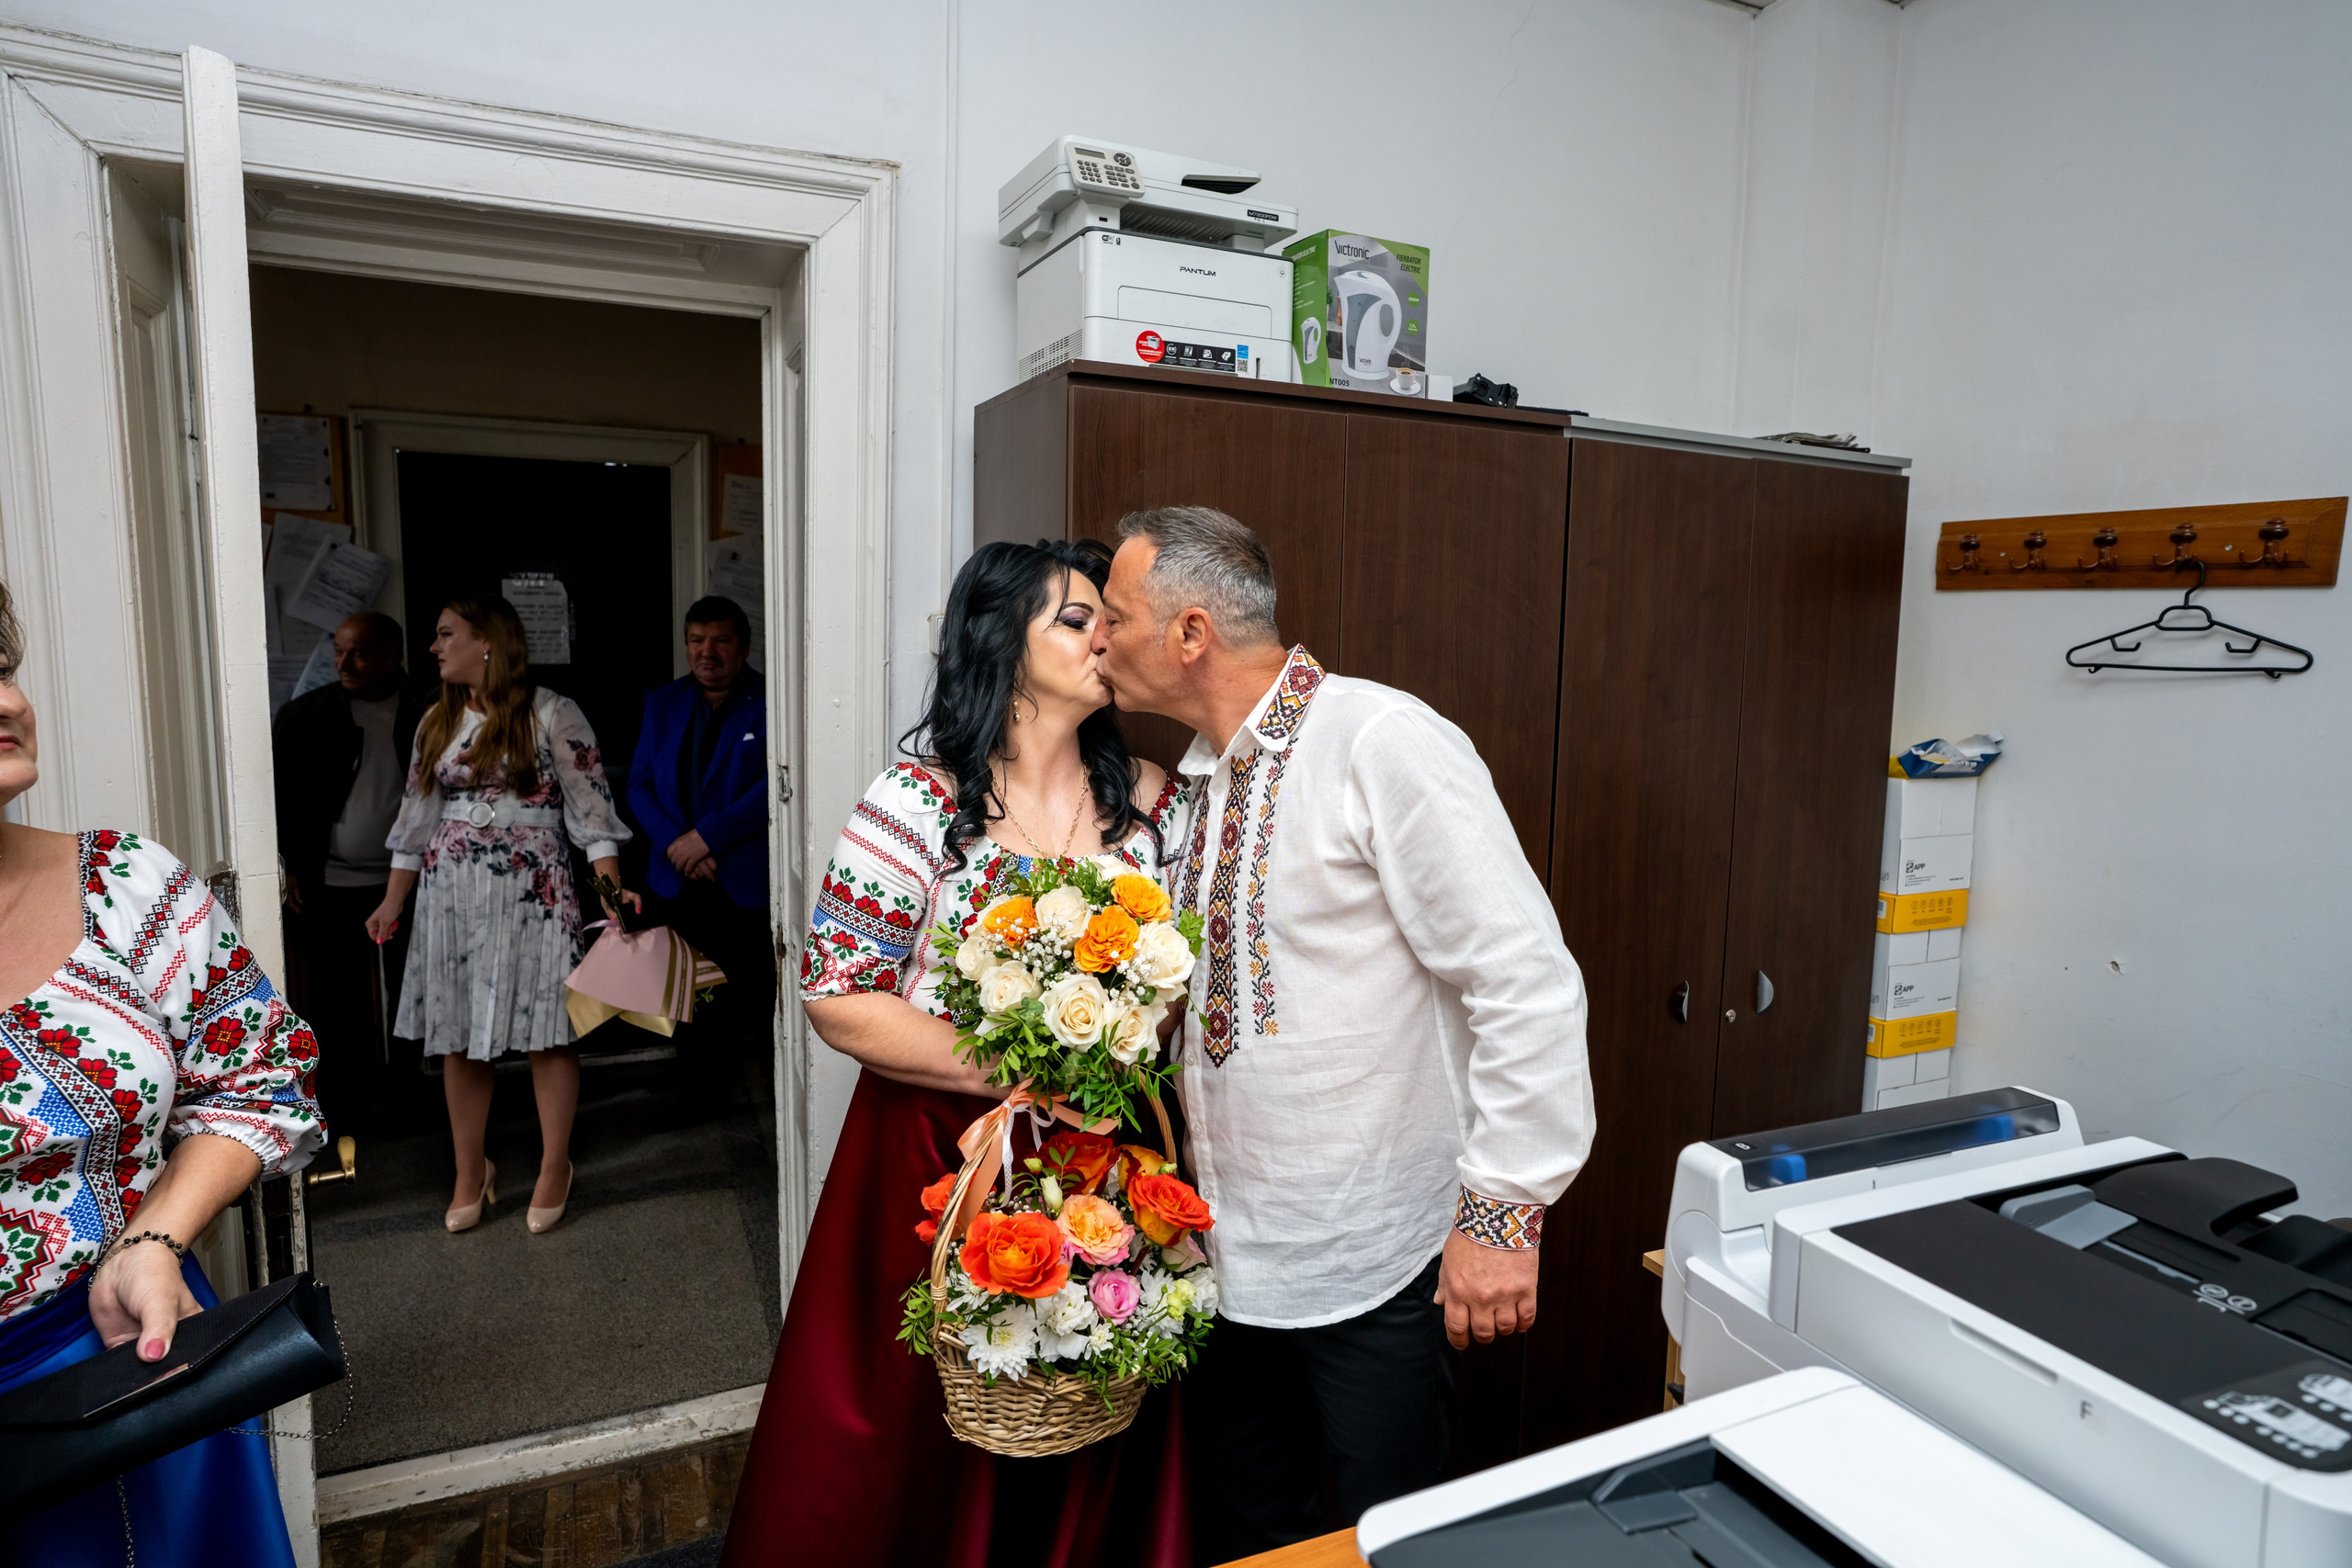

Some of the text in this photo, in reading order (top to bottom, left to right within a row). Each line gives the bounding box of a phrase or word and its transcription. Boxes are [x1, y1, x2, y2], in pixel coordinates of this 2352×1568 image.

[1334, 240, 1370, 259] Victronic
[1396, 254, 1421, 265] FIERBATOR
[1180, 265, 1216, 276] PANTUM
[1400, 263, 1421, 275] ELECTRIC
[1329, 377, 1350, 387] NT005
[1914, 863, 1926, 871] APP
[1902, 985, 1915, 993] APP
